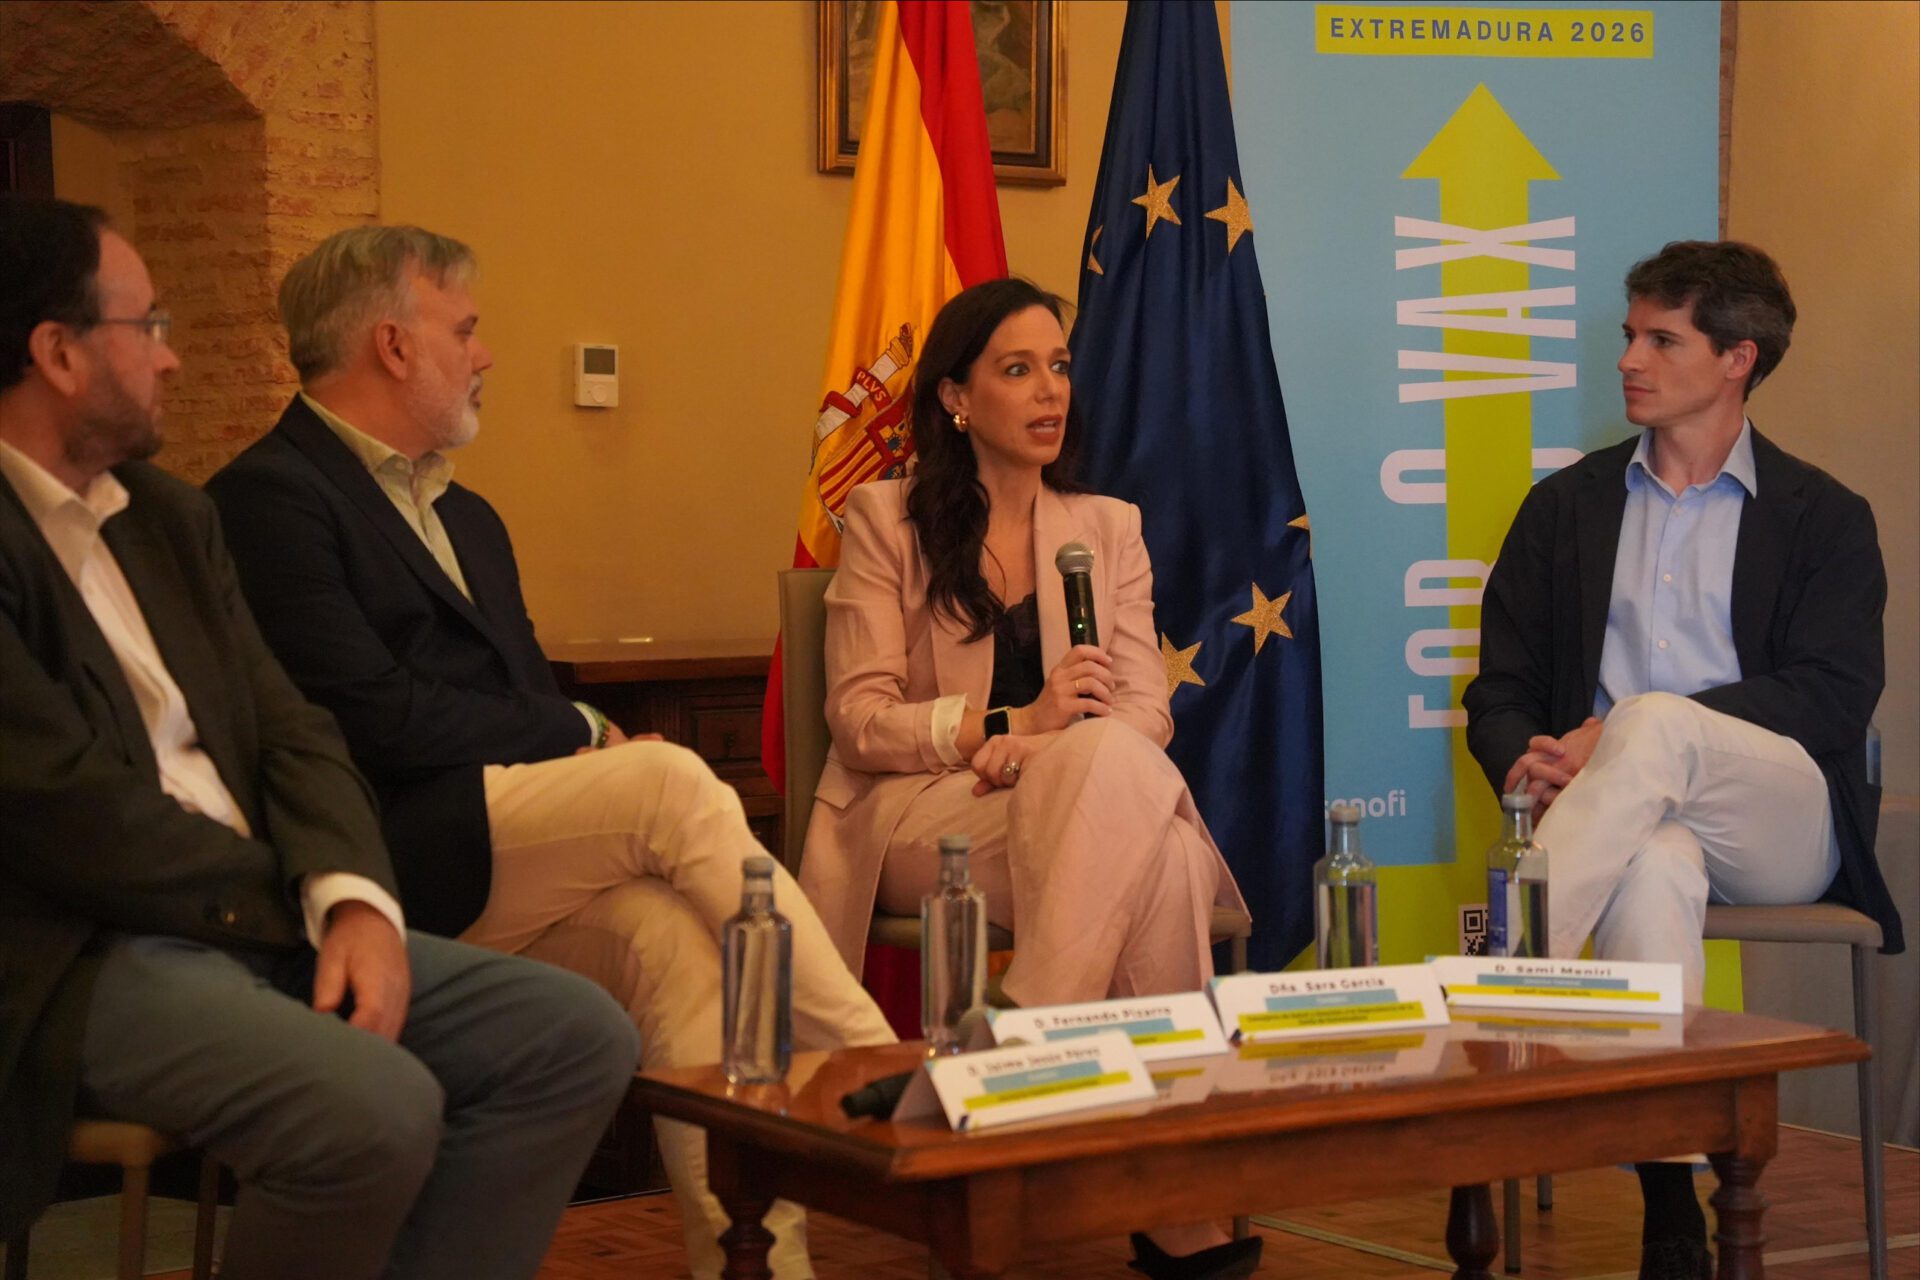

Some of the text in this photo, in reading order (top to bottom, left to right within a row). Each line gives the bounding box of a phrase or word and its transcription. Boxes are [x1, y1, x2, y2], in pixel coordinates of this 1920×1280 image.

[1330, 17, 1646, 43] EXTREMADURA 2026
[1394, 215, 1577, 404] VAX
[857, 370, 887, 402] PLVS
